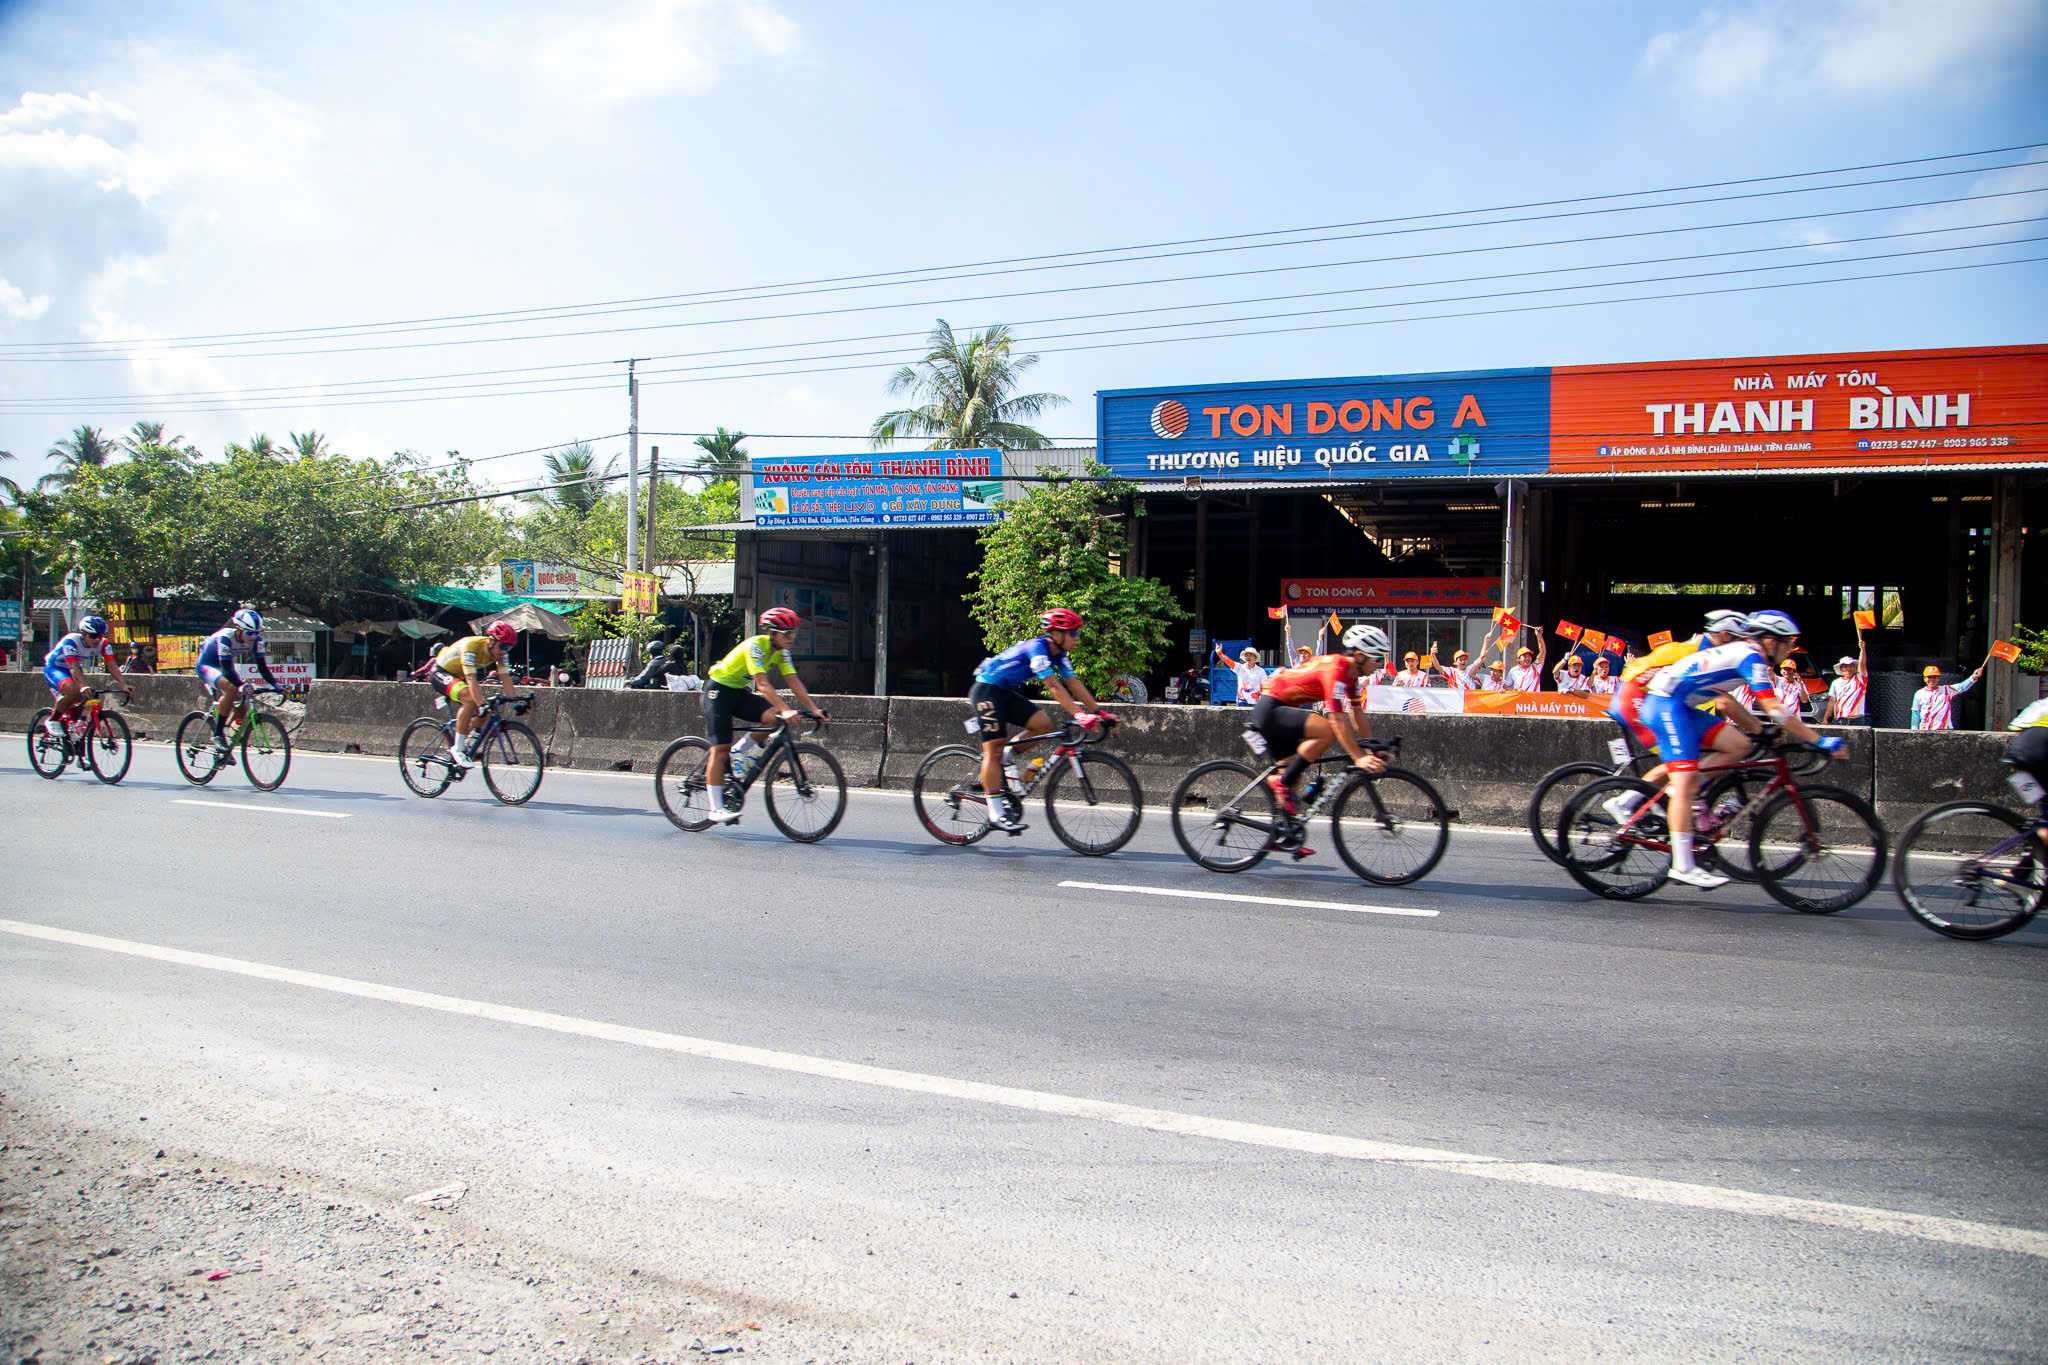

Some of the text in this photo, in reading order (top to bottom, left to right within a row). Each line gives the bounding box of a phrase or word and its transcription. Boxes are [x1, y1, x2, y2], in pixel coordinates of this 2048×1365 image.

[1733, 370, 1877, 391] NHÀ MÁY TÔN
[1202, 394, 1487, 438] TON DONG A
[1645, 385, 1971, 437] THANH BÌNH
[1785, 443, 1812, 452] GIANG
[1870, 440, 1898, 450] 02733
[1901, 440, 1918, 449] 627
[1919, 439, 1936, 448] 447
[1146, 440, 1430, 471] THƯƠNG HIỆU QUỐC GIA
[879, 458, 941, 477] THANH
[945, 453, 990, 477] BÌNH
[862, 483, 874, 496] TÔN
[891, 482, 904, 495] TÔN
[924, 481, 936, 494] TÔN
[906, 498, 927, 511] XÂY
[1306, 587, 1376, 597] TON DONG A
[1515, 702, 1585, 714] NHÀ MÁY TÔN
